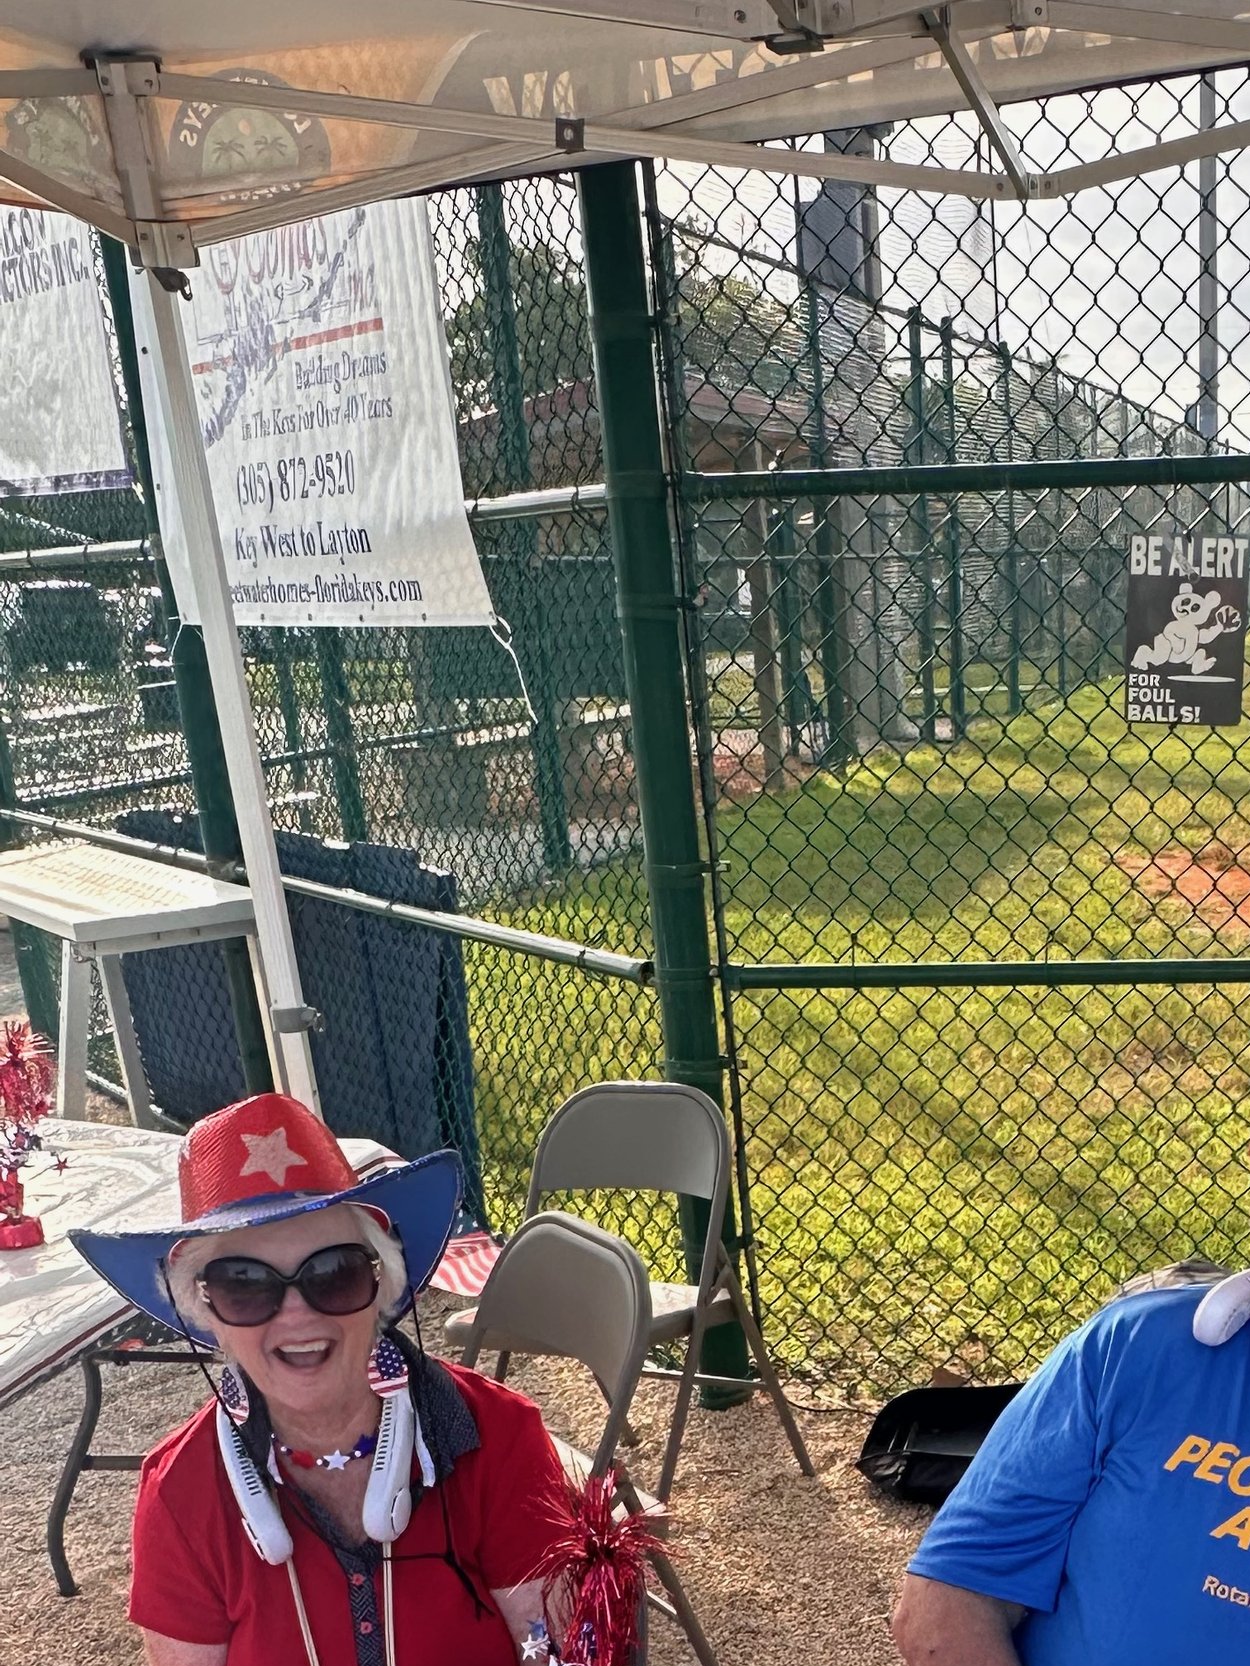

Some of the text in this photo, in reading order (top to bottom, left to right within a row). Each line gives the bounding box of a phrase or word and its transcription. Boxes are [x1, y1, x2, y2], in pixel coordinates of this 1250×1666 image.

[234, 521, 373, 568] Key West to Layton
[1130, 535, 1249, 579] BE ALERT
[1128, 674, 1161, 687] FOR
[1128, 688, 1176, 703] FOUL
[1127, 704, 1201, 724] BALLS!
